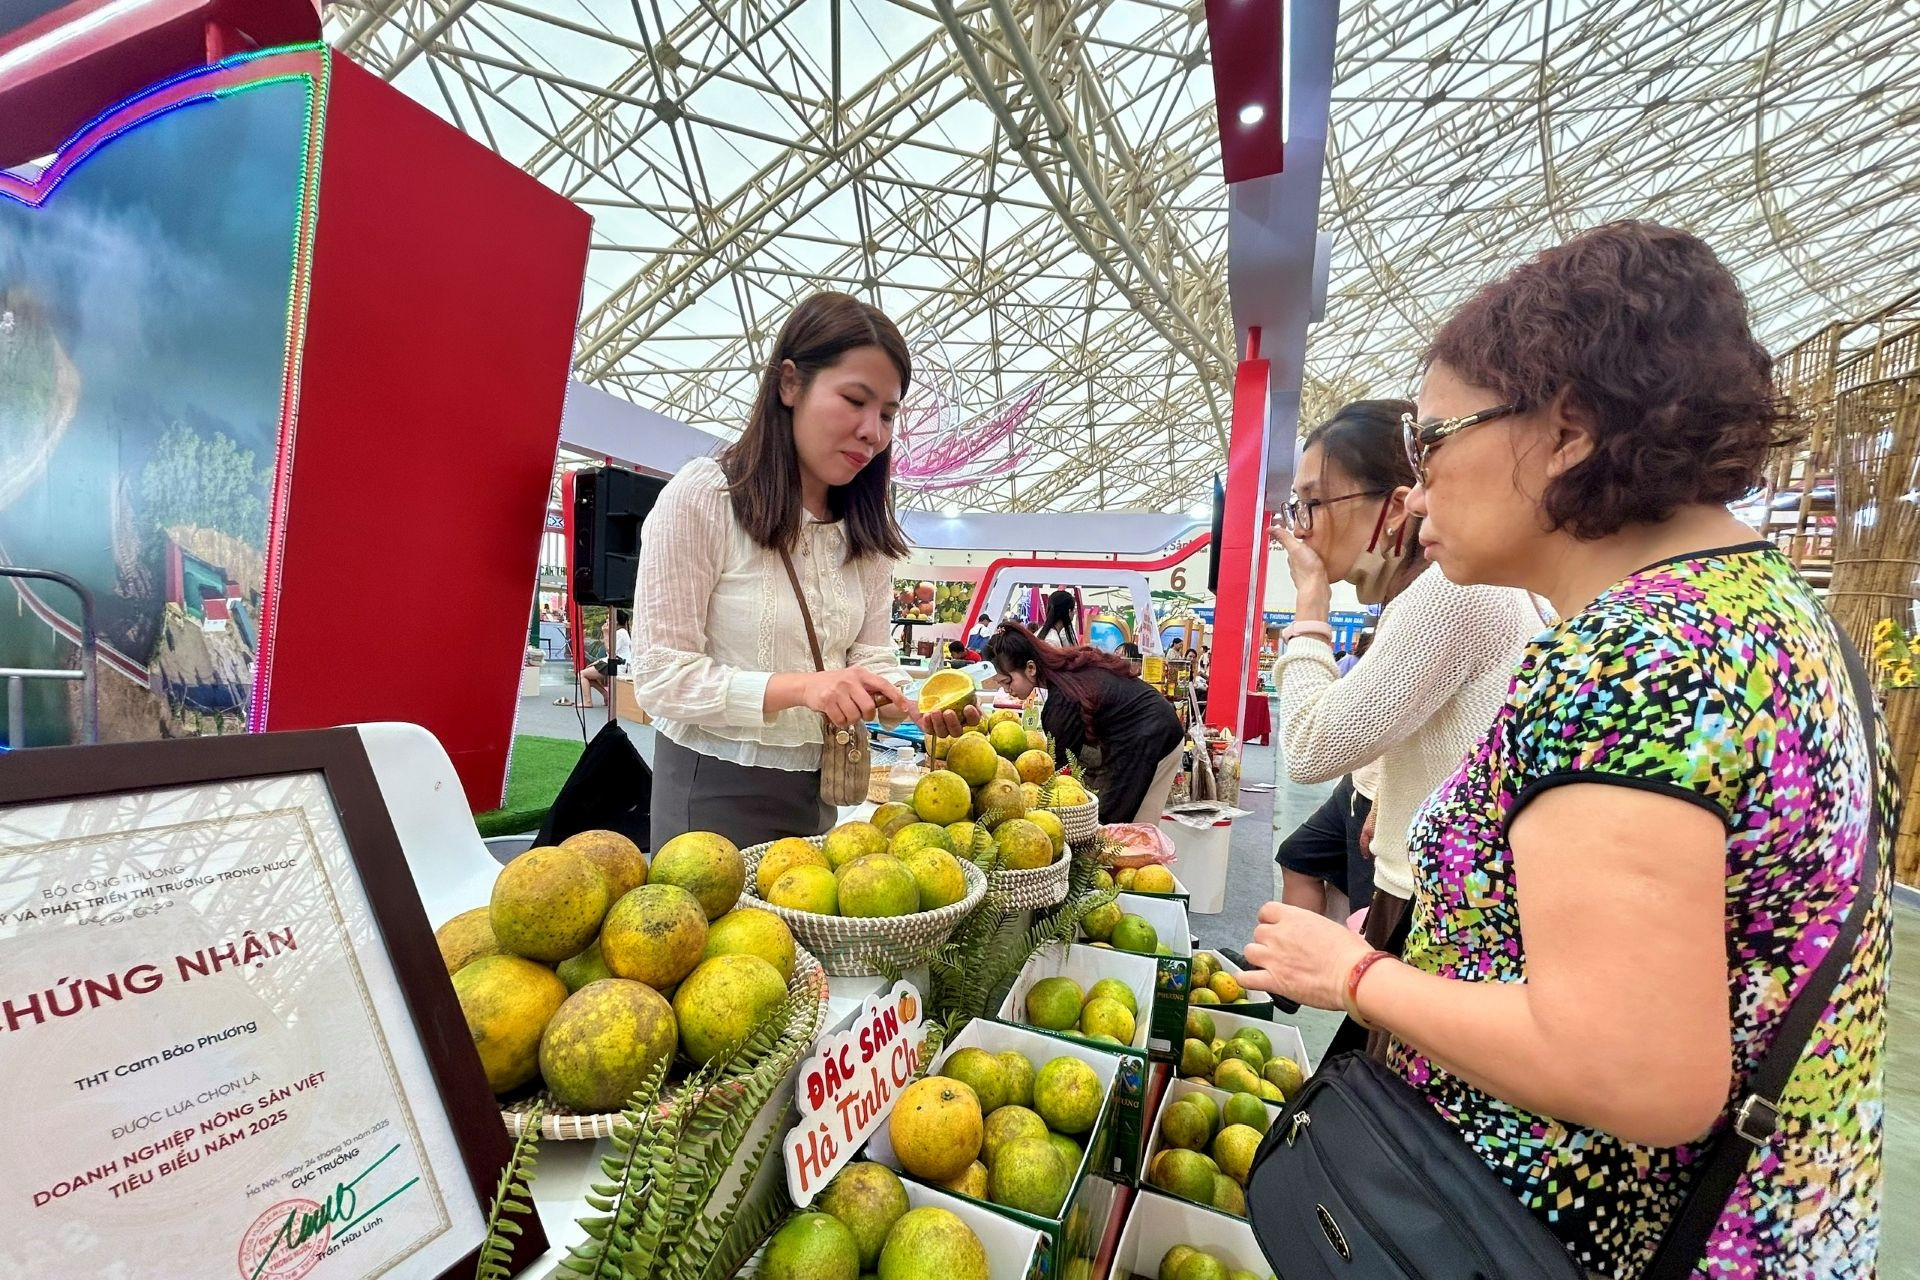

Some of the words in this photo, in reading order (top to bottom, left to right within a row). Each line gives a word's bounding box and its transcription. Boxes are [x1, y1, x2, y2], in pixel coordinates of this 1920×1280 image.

[1170, 567, 1186, 591] 6
[13, 908, 37, 922] VÀ
[41, 900, 82, 917] PHÁT
[85, 890, 128, 908] TRIỂN
[131, 887, 155, 898] THỊ
[157, 875, 215, 894] TRƯỜNG
[217, 866, 260, 881] TRONG
[263, 859, 297, 872] NƯỚC
[42, 885, 67, 899] BỘ
[72, 877, 120, 894] CÔNG
[123, 865, 185, 884] THƯƠNG
[0, 965, 163, 1032] HỨNG
[175, 927, 298, 983] NHẬN
[74, 1071, 109, 1091] THT
[114, 1056, 160, 1077] Cam
[162, 1041, 195, 1061] Bảo
[198, 1020, 257, 1049] Phương
[807, 1044, 855, 1111] ĐẶC
[860, 1005, 899, 1064] SẢN
[32, 1161, 118, 1208] DOANH
[122, 1128, 195, 1168] NGHIỆP
[200, 1102, 255, 1134] NÔNG
[258, 1086, 292, 1109] SẢN
[293, 1070, 326, 1093] VIỆT
[111, 1111, 163, 1140] ĐƯỢC
[165, 1099, 195, 1118] LỰA
[197, 1079, 241, 1105] CHỌN
[243, 1072, 261, 1089] LÀ
[108, 1170, 154, 1199] TIÊU
[158, 1149, 200, 1177] BIỂU
[204, 1129, 246, 1156] NĂM
[249, 1109, 288, 1136] 2025
[281, 1166, 303, 1180] ngày
[372, 1119, 390, 1133] 2025
[291, 1171, 316, 1189] CỤC
[317, 1148, 360, 1176] TRƯỞNG
[795, 1122, 838, 1192] Hà
[342, 1231, 361, 1245] Hữu
[363, 1217, 384, 1232] Linh
